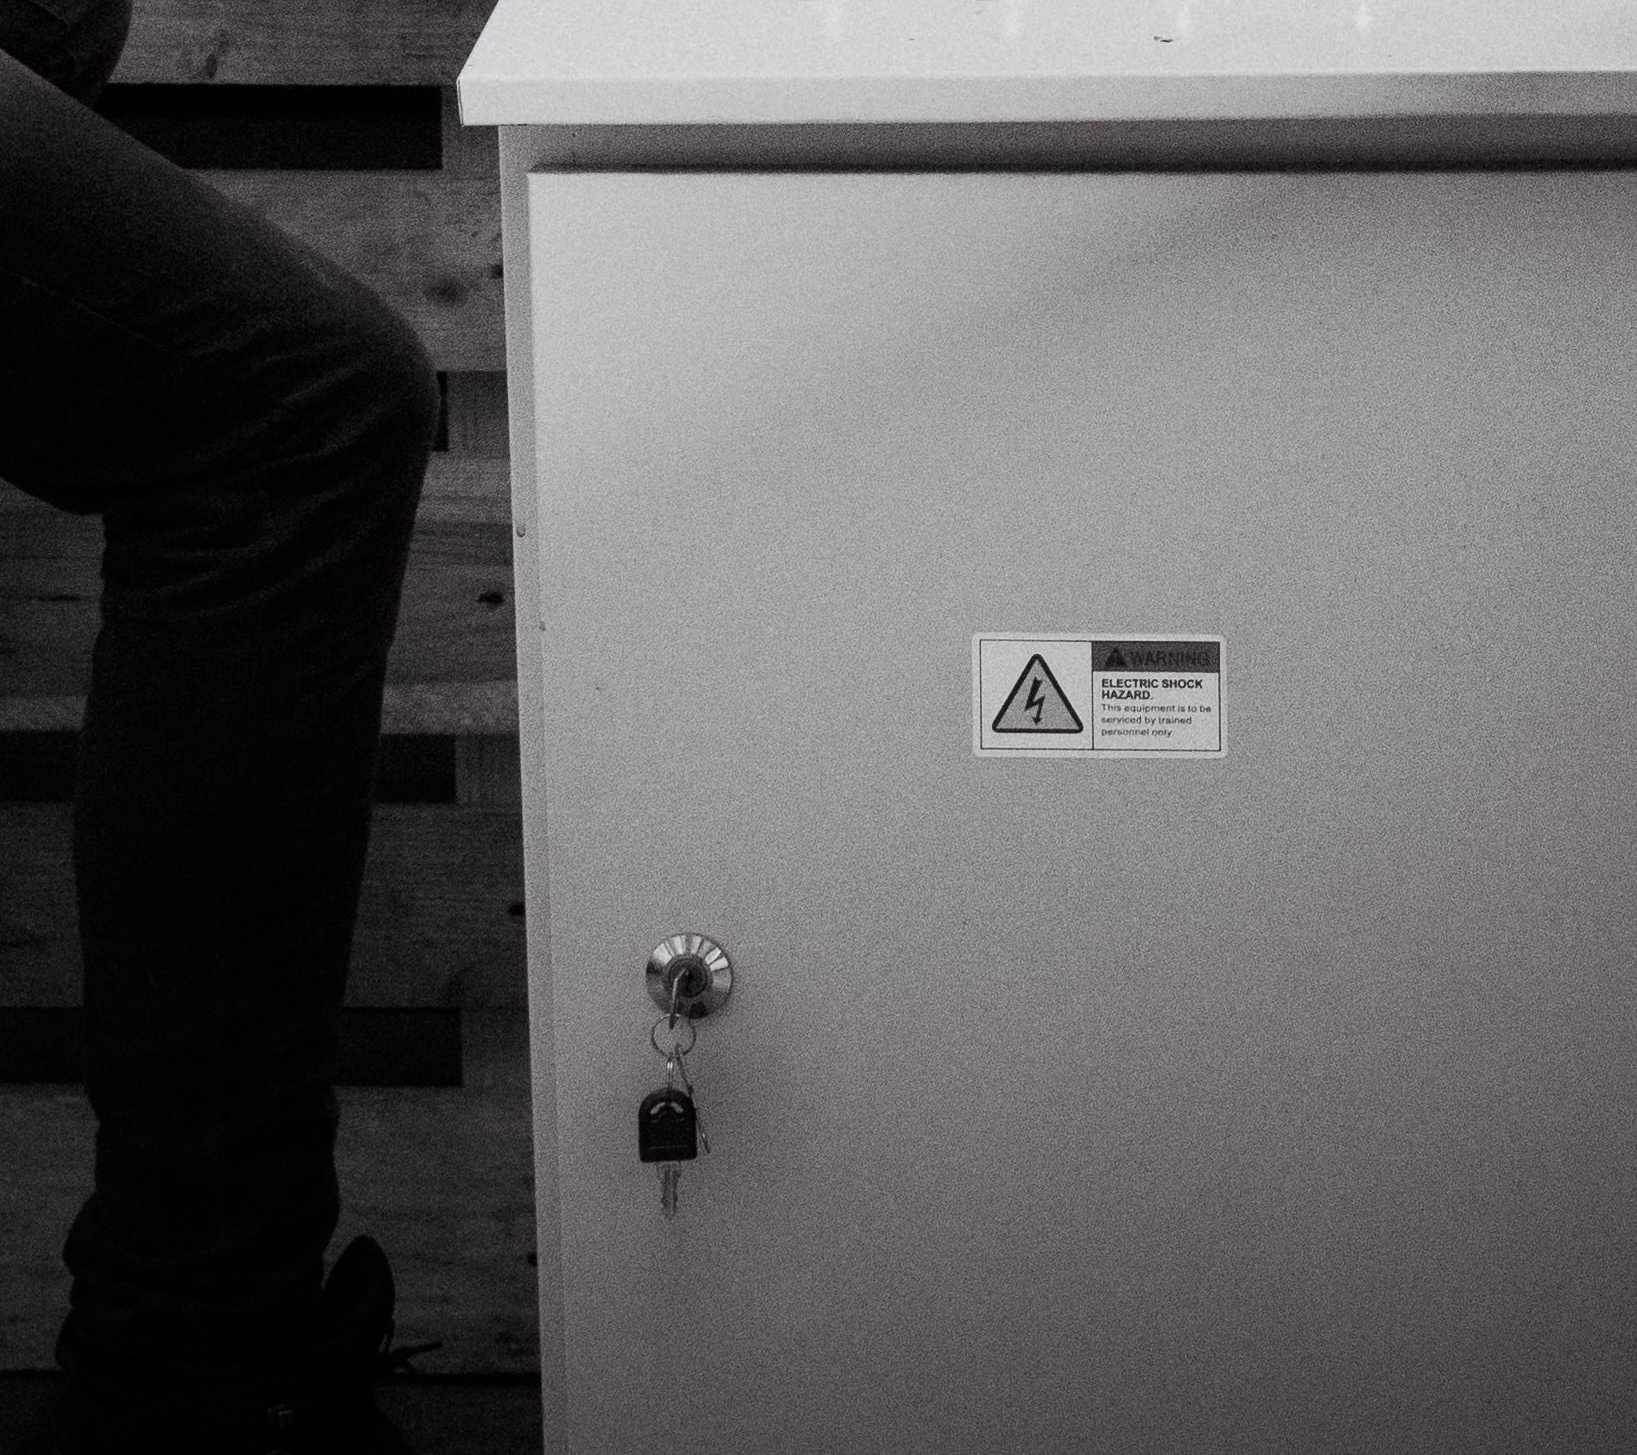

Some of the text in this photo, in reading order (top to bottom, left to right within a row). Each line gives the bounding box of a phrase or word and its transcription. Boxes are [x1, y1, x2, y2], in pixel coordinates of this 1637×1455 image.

[1129, 650, 1211, 667] WARNING
[1101, 678, 1204, 689] ELECTRIC SHOCK
[1101, 690, 1154, 700] HAZARD.
[1101, 703, 1212, 714] This equipment is to be
[1101, 716, 1192, 726] serviced by trained
[1101, 729, 1149, 737] personnel
